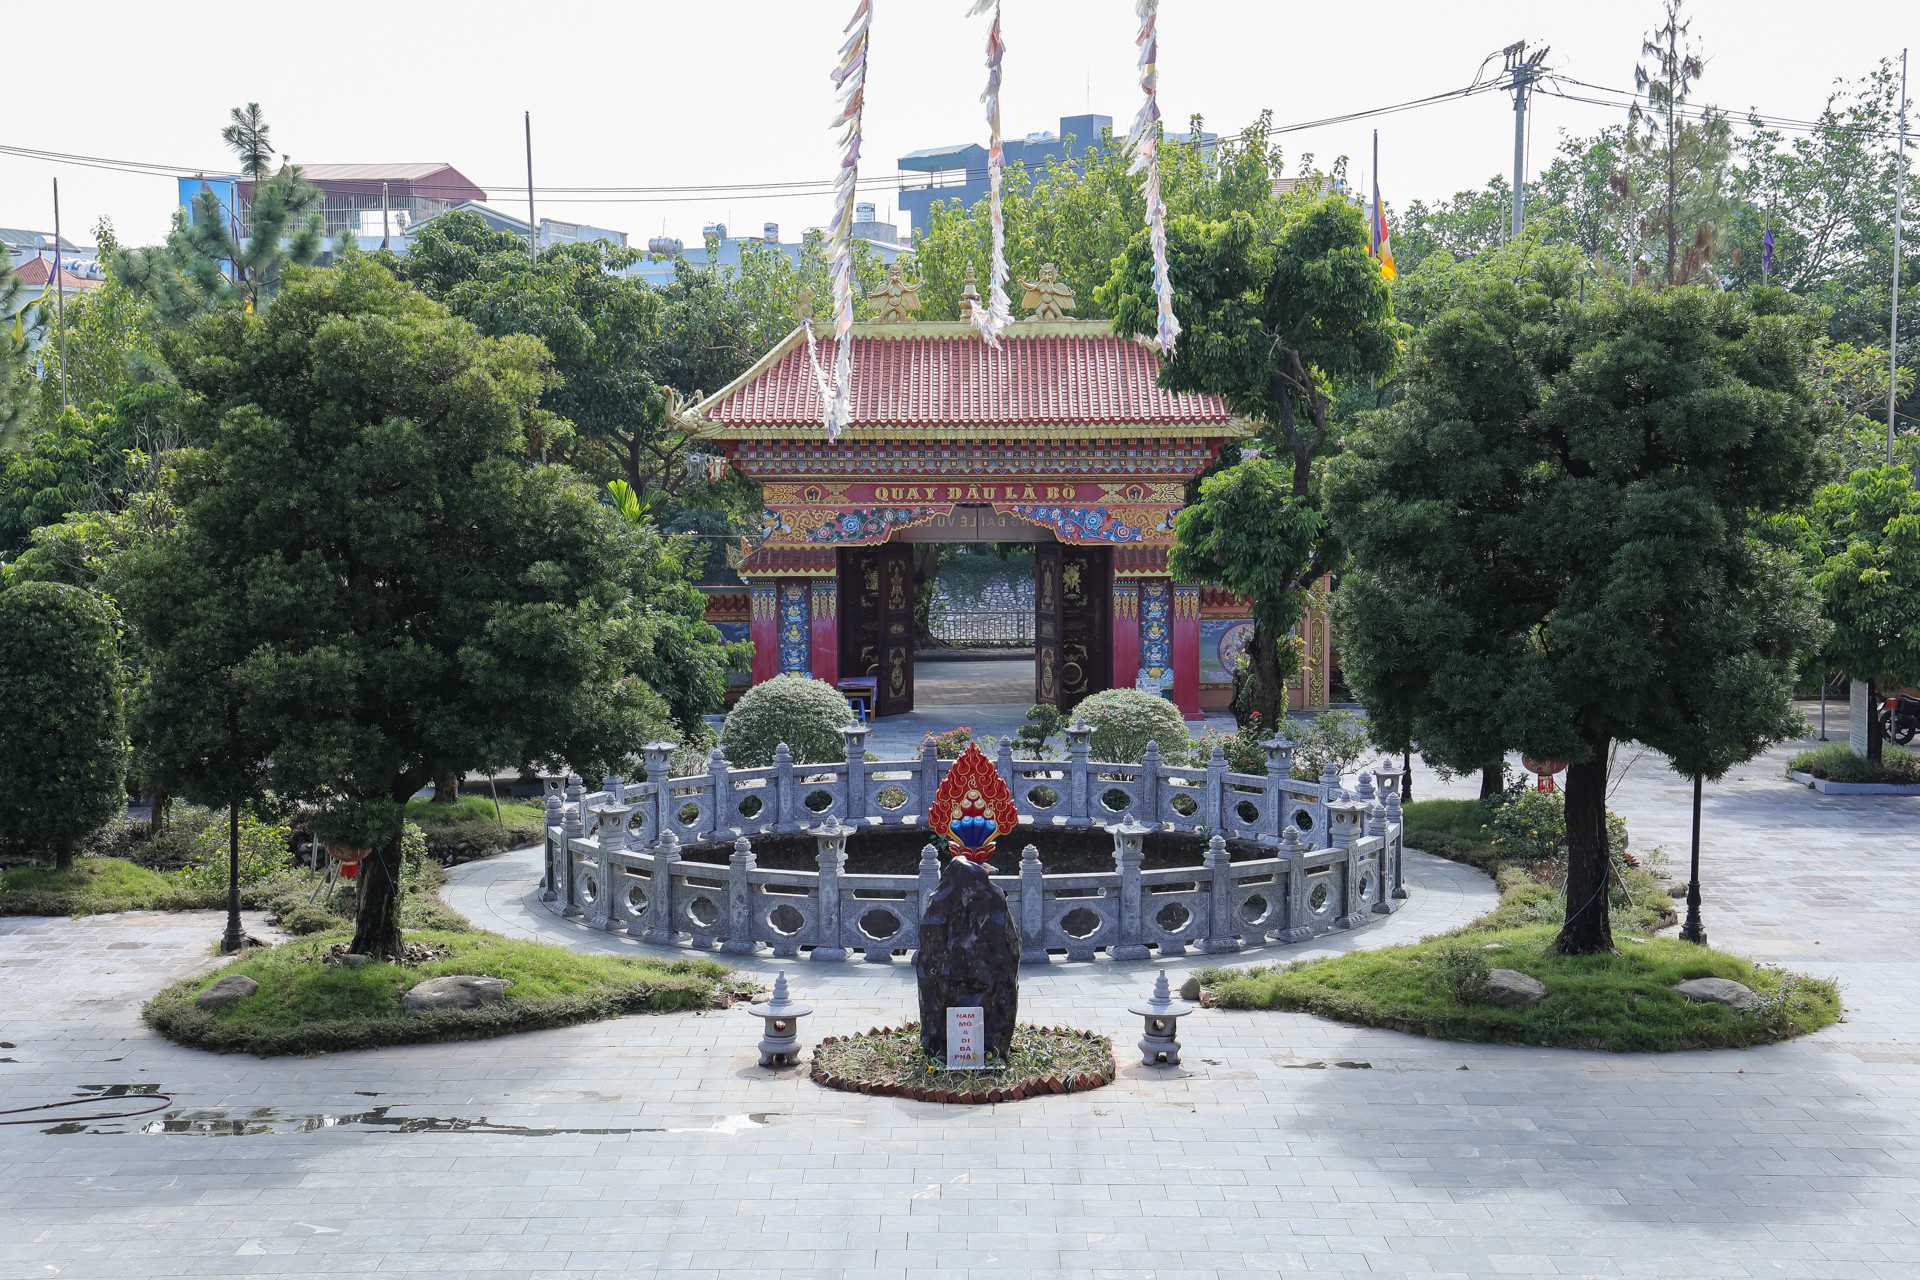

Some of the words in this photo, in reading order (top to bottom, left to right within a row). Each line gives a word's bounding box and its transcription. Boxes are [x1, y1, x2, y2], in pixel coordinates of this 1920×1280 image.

[874, 486, 938, 501] QUAY
[947, 483, 996, 500] ĐẦU
[1004, 483, 1038, 500] LÀ
[1045, 483, 1076, 500] BÒ
